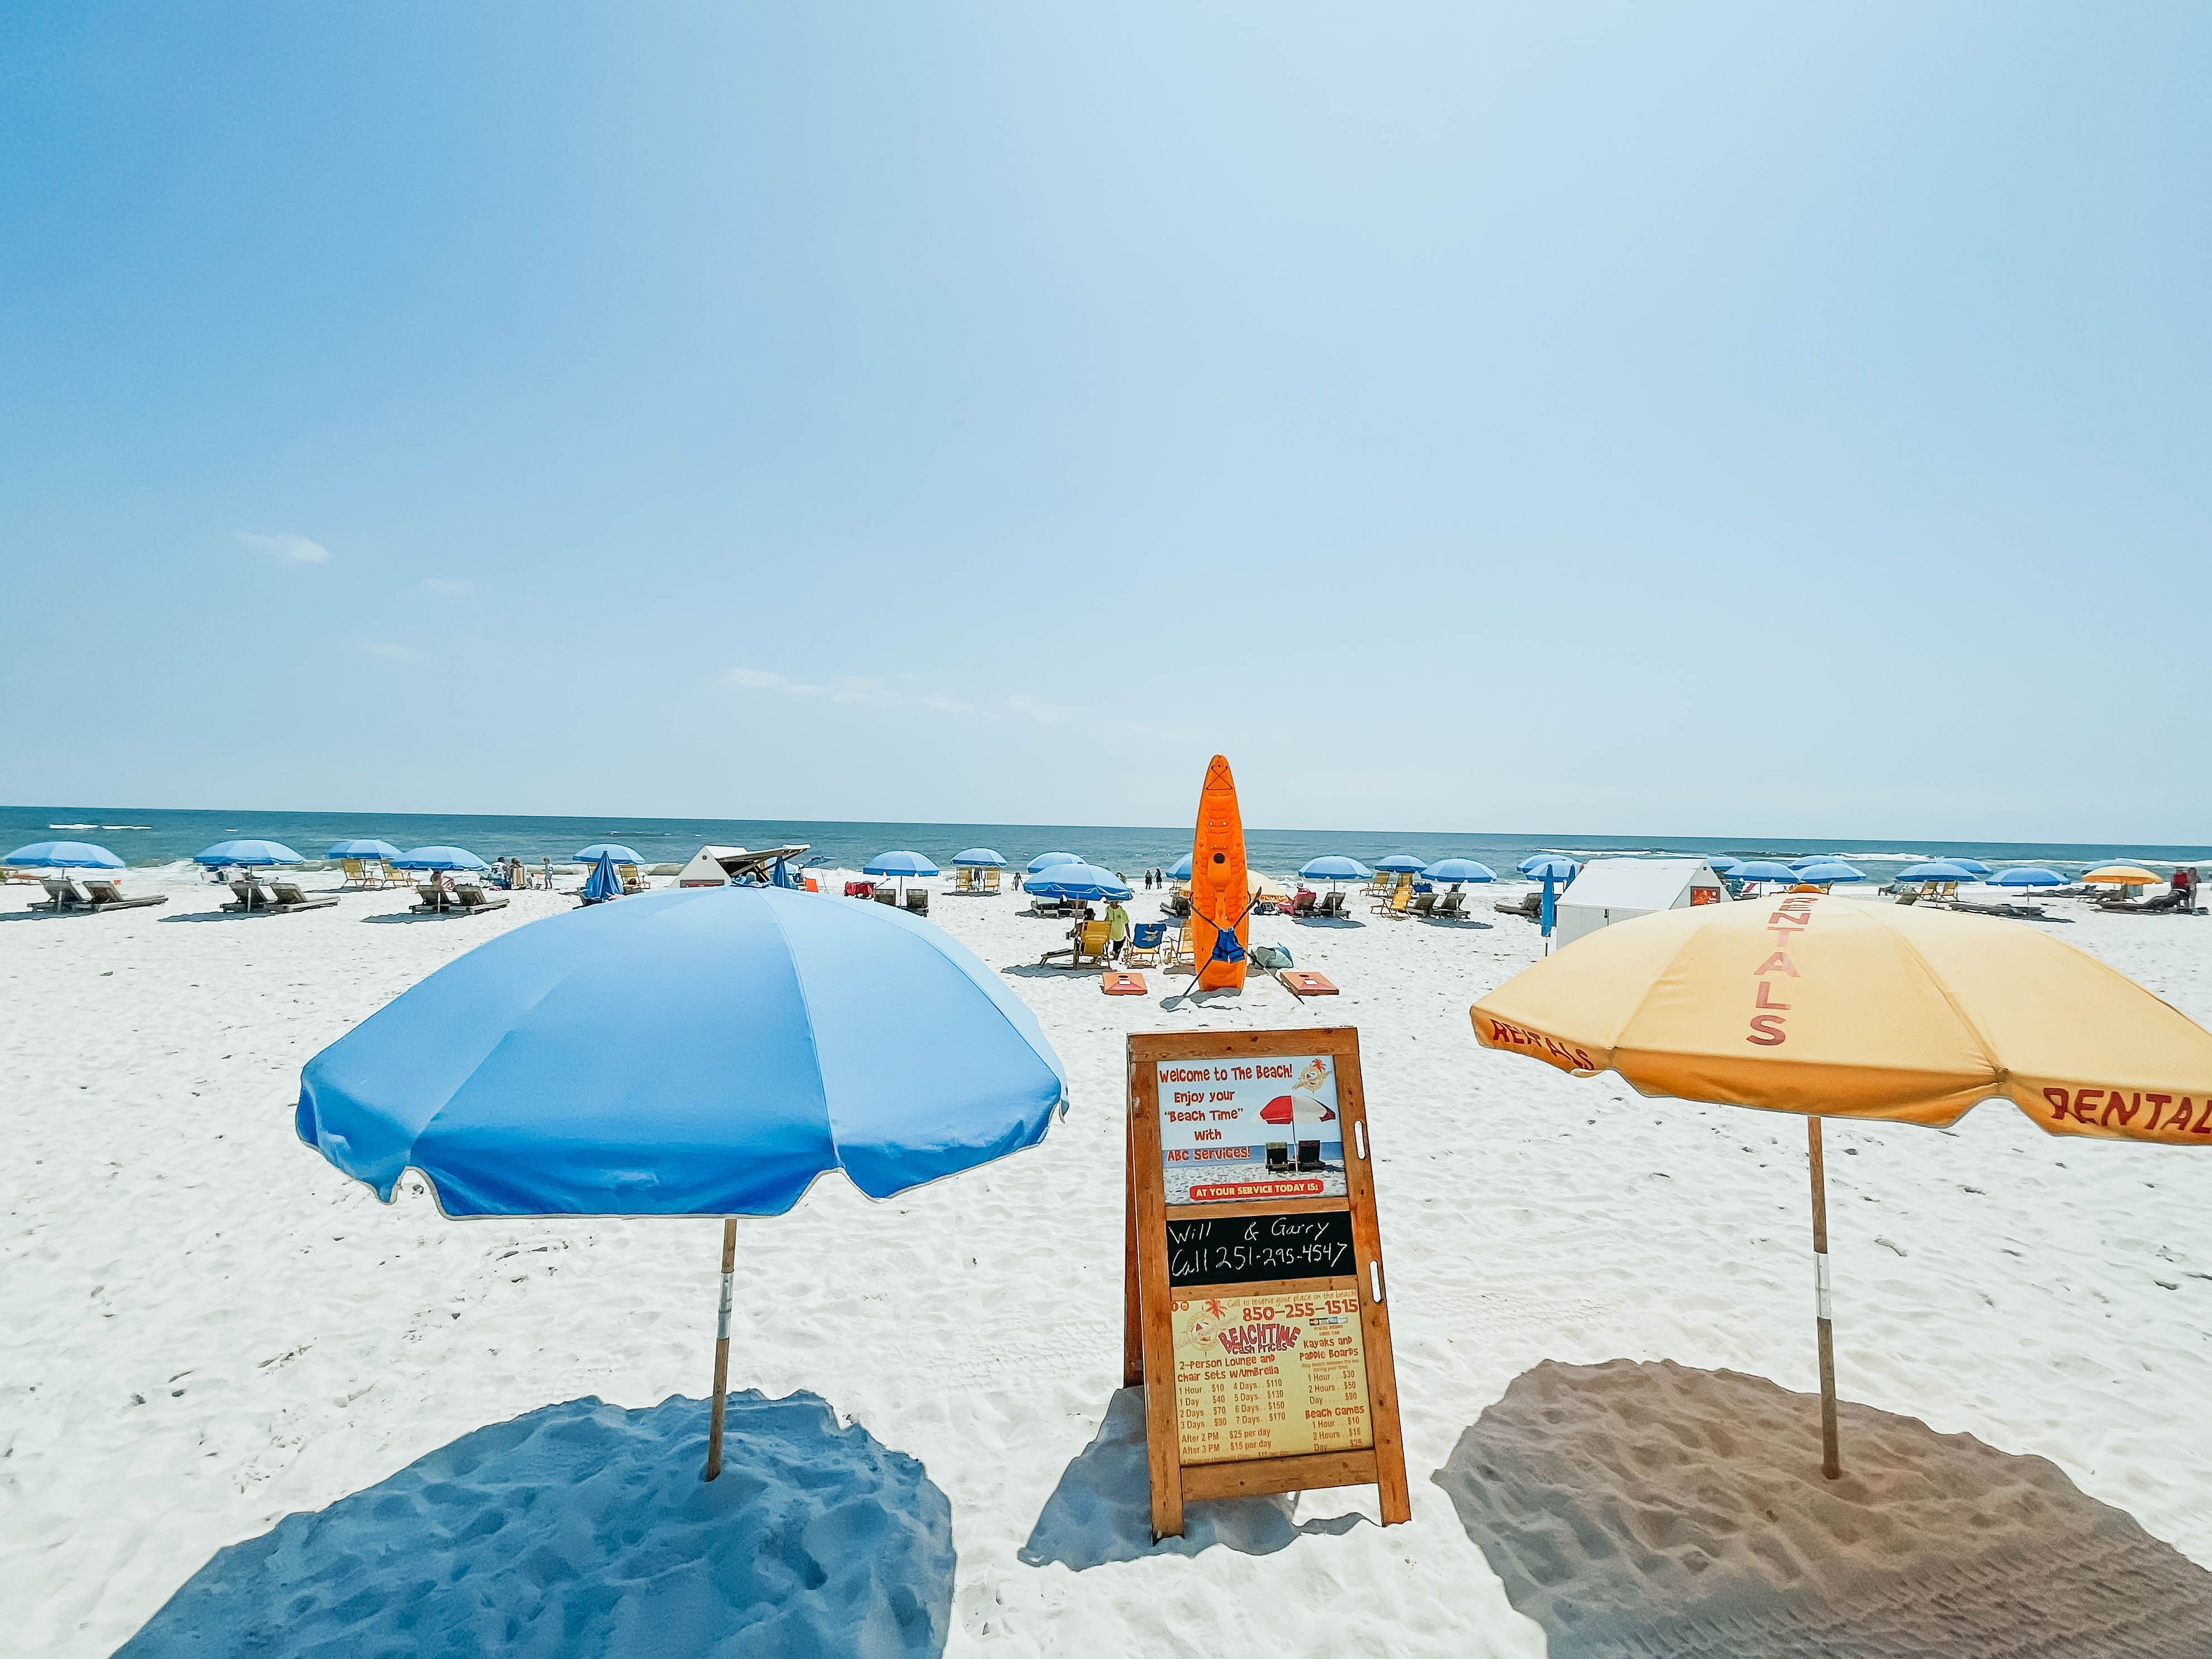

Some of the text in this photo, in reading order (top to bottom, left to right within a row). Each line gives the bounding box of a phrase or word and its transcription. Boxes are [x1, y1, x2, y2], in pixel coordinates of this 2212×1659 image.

[1746, 897, 1819, 1045] RENTALS
[1159, 1064, 1292, 1083] Welcome to The Beach!
[1174, 1091, 1235, 1106] Enjoy your
[1167, 1150, 1189, 1161] ABC
[1196, 1188, 1207, 1197] AT
[1209, 1187, 1235, 1196] YOUR
[1237, 1185, 1273, 1195] SERVICE
[1275, 1183, 1305, 1193] TODAY
[1168, 1217, 1329, 1244] Will & Garry
[1172, 1242, 1347, 1276] Call 251-295-4547
[1227, 1299, 1241, 1308] Call
[1242, 1299, 1359, 1322] 850-255-1515
[1218, 1323, 1301, 1354] BEACHTIME
[1303, 1338, 1334, 1349] Kayaks
[1225, 1356, 1257, 1367] Lounge
[1343, 1370, 1355, 1379] $30
[1212, 1384, 1225, 1392] $10
[1239, 1382, 1258, 1391] Days
[1266, 1378, 1282, 1387] $110
[1344, 1381, 1356, 1390] $50
[1185, 1398, 1199, 1407] Day
[1212, 1395, 1225, 1404] $40
[1241, 1393, 1258, 1402] Days
[1268, 1390, 1284, 1399] $130
[1310, 1392, 1357, 1405] Day $90
[1186, 1409, 1204, 1419] Days
[1214, 1406, 1226, 1416] $70
[1241, 1404, 1259, 1414] Days
[1268, 1401, 1285, 1411] $150
[1305, 1406, 1364, 1419] Beach Games
[1187, 1420, 1205, 1430] Days
[1214, 1418, 1226, 1427] $90
[1242, 1415, 1260, 1425] Days
[1269, 1412, 1285, 1422] $170
[1347, 1416, 1360, 1425] $10
[1182, 1434, 1199, 1443] After
[1208, 1432, 1219, 1440] PM
[1230, 1430, 1242, 1439] $25
[1244, 1430, 1256, 1440] per
[1258, 1428, 1271, 1438] day
[1313, 1432, 1317, 1440] 2
[1183, 1446, 1199, 1455] After
[1209, 1443, 1220, 1452] PM
[1230, 1441, 1243, 1451] $15
[1245, 1442, 1257, 1451] per
[1259, 1440, 1271, 1449] day
